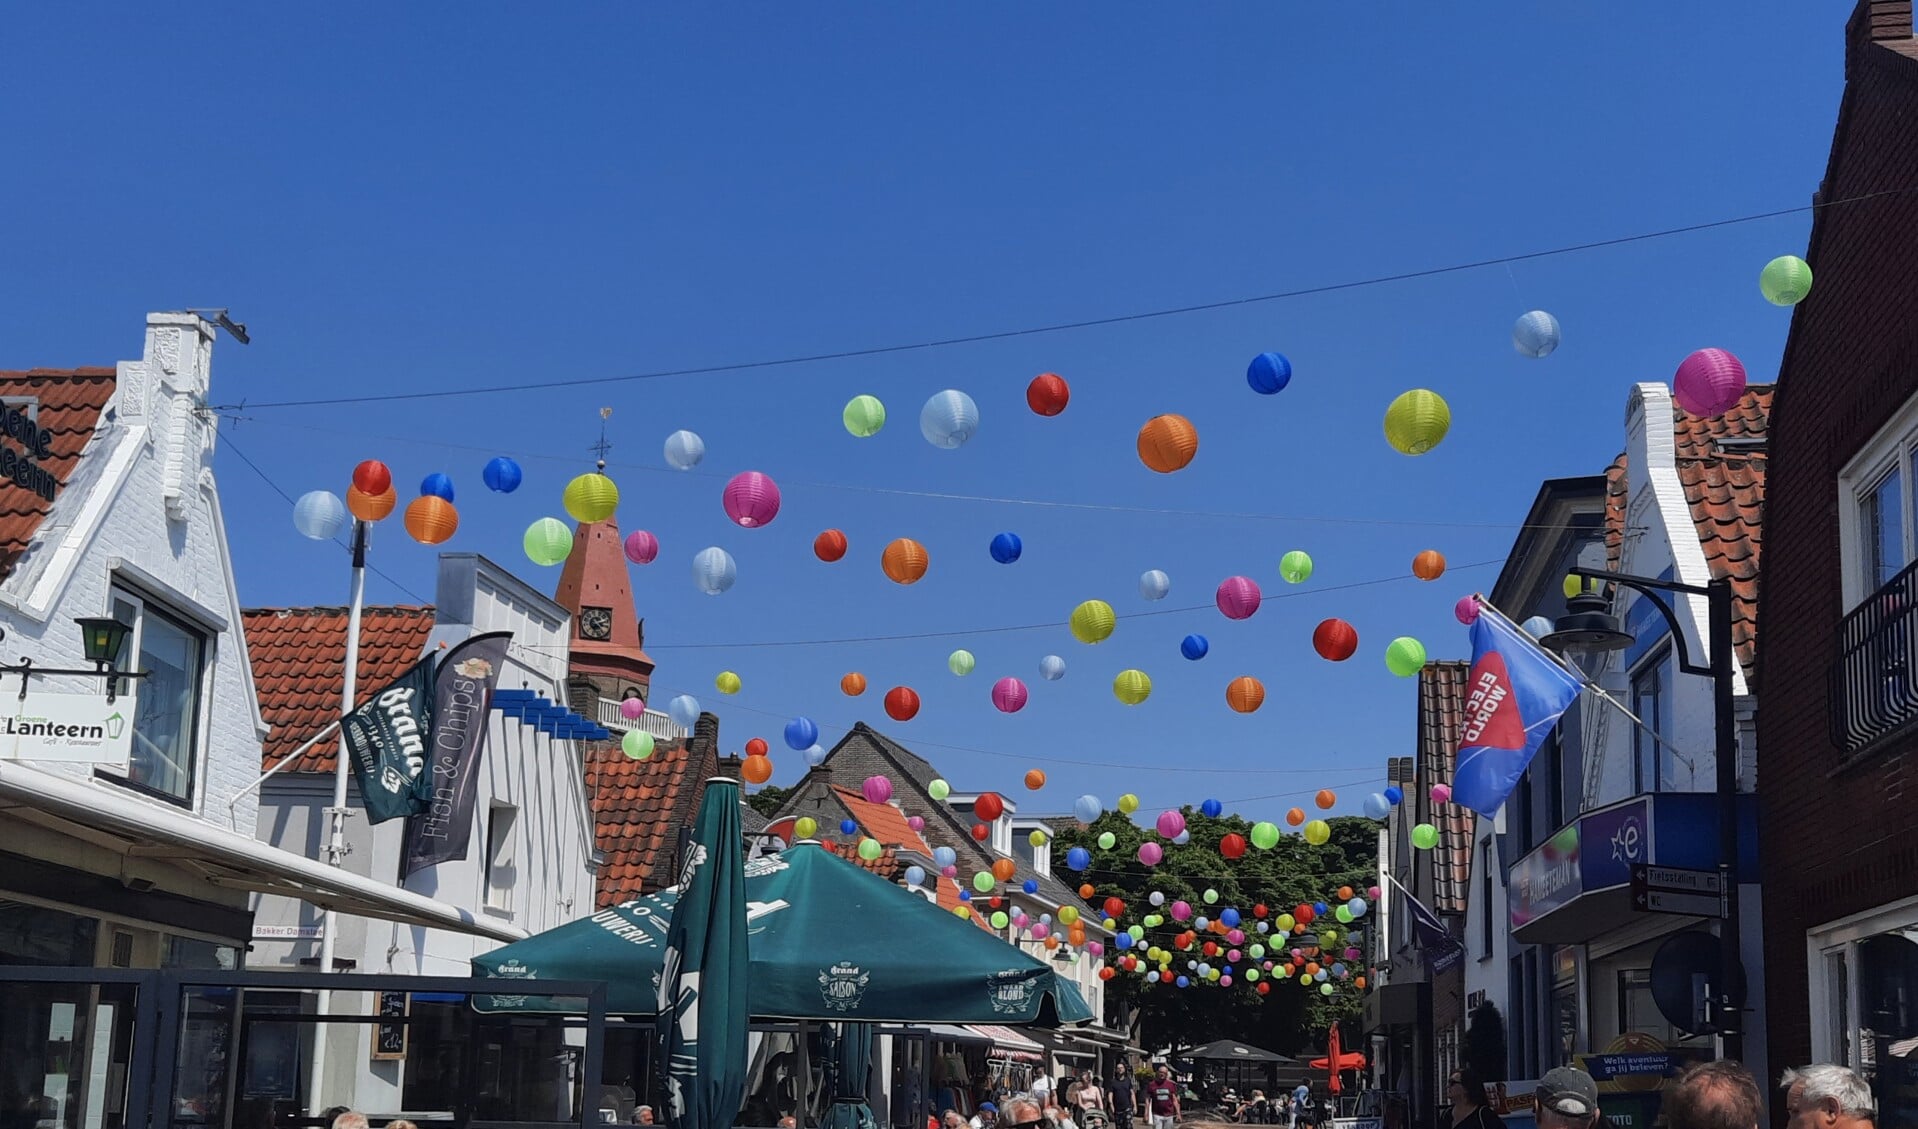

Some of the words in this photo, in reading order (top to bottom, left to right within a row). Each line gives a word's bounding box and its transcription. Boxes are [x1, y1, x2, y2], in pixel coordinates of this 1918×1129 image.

[437, 679, 480, 751] Chips
[6, 717, 103, 739] Lanteern
[368, 724, 385, 749] 1340
[432, 756, 460, 779] &
[420, 787, 455, 841] Fish
[829, 981, 857, 998] SAISON
[1603, 1056, 1626, 1065] Welk
